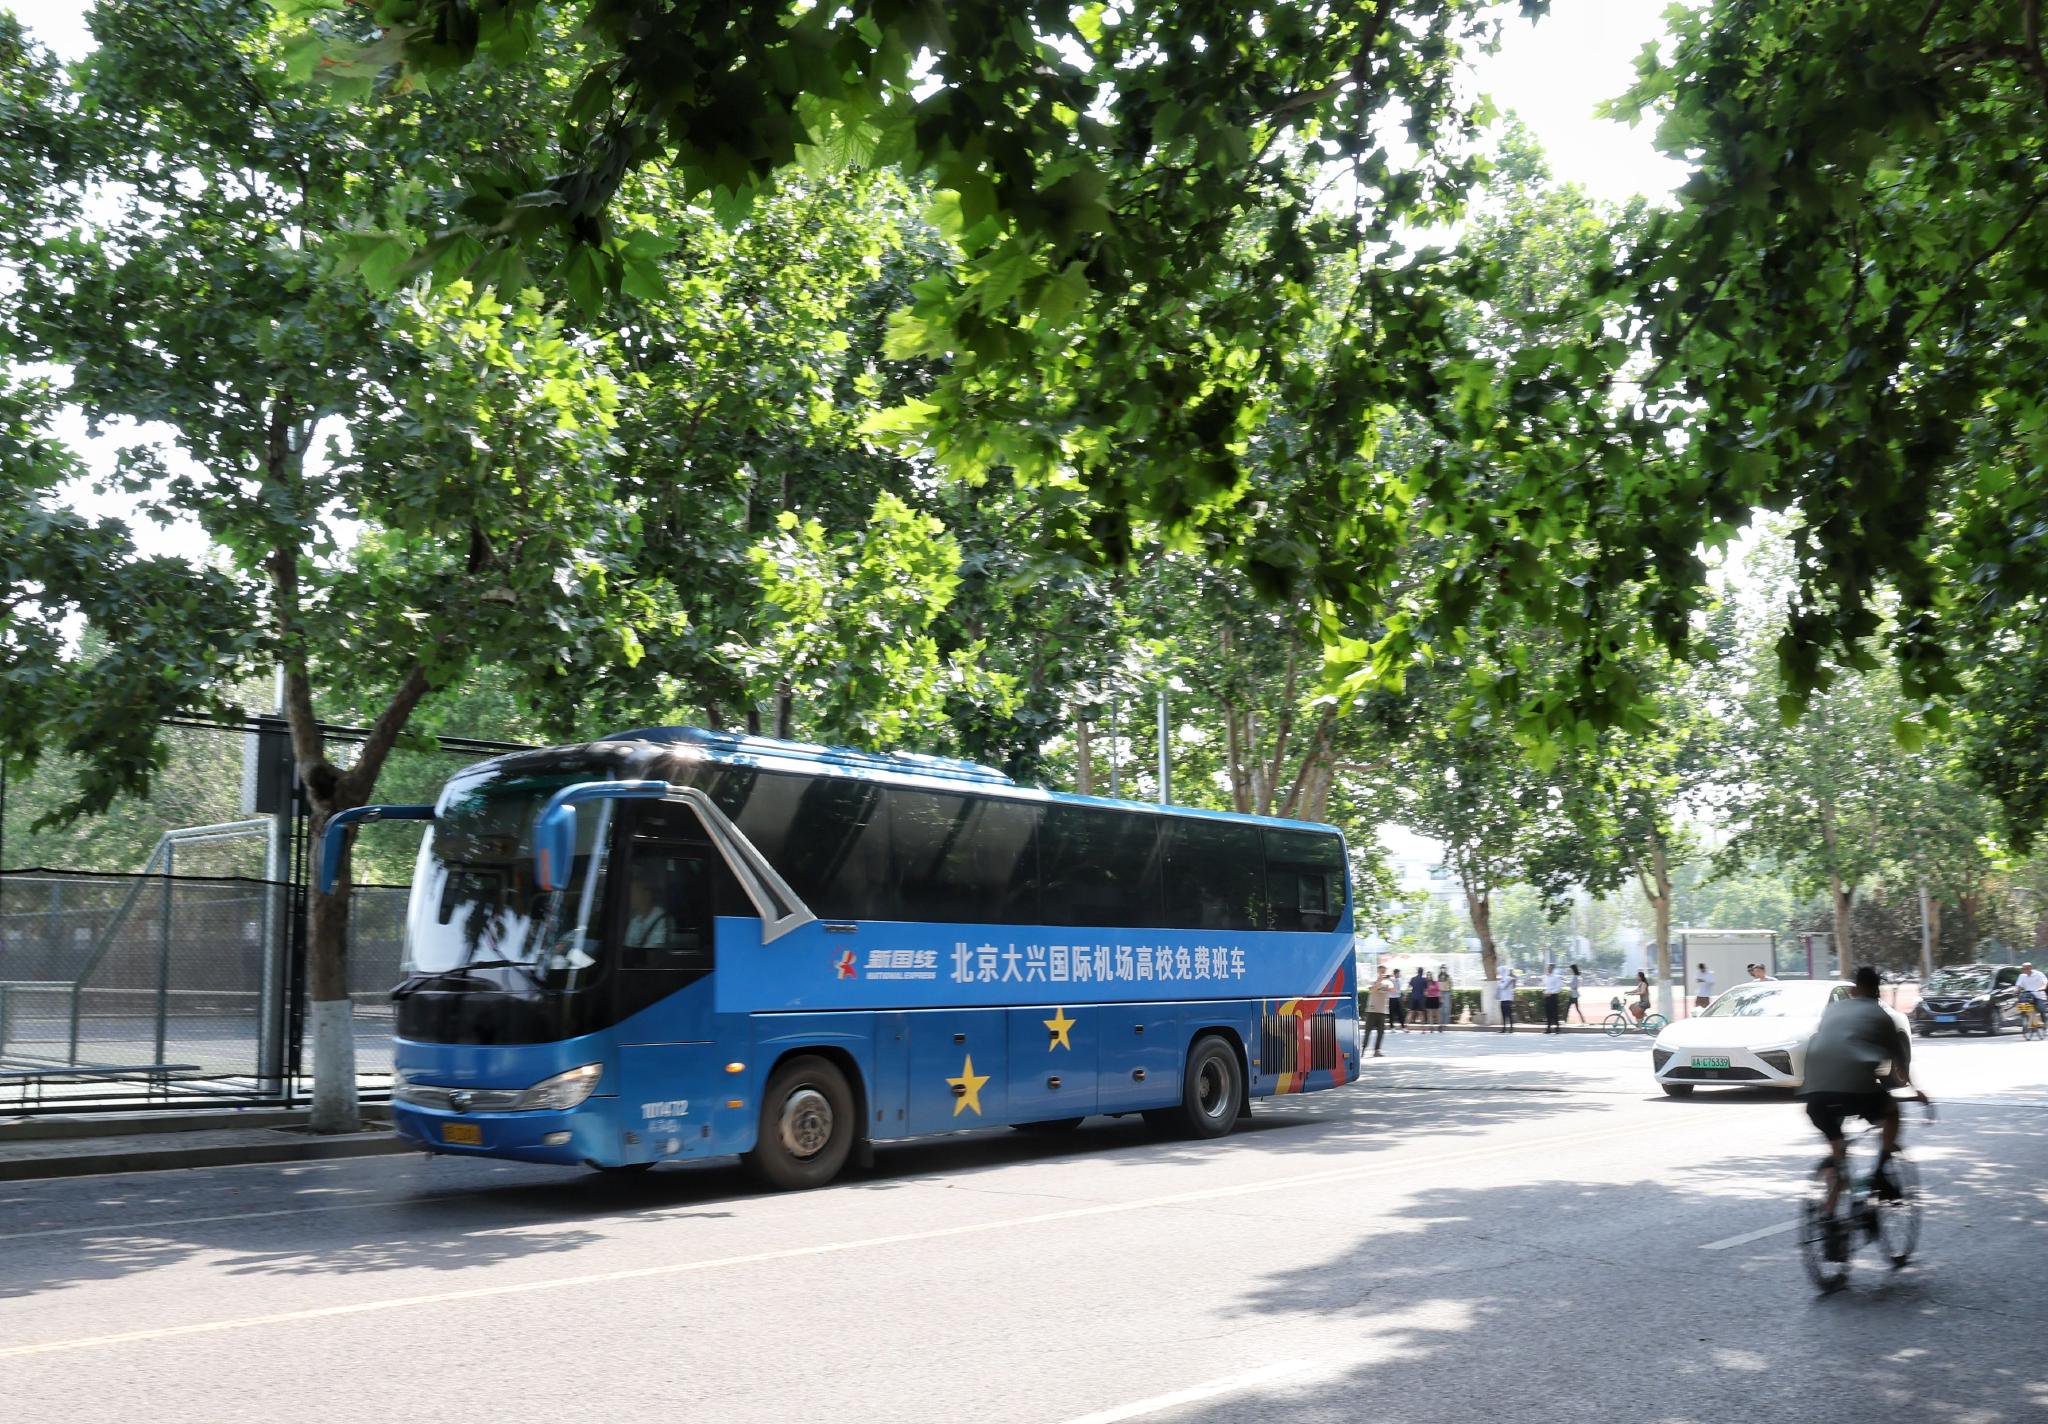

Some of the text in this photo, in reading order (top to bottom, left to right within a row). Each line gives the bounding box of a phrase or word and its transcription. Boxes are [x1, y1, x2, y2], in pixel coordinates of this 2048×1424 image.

[864, 950, 938, 968] 新国线
[950, 942, 1246, 983] 北京大兴国际机场高校免费班车
